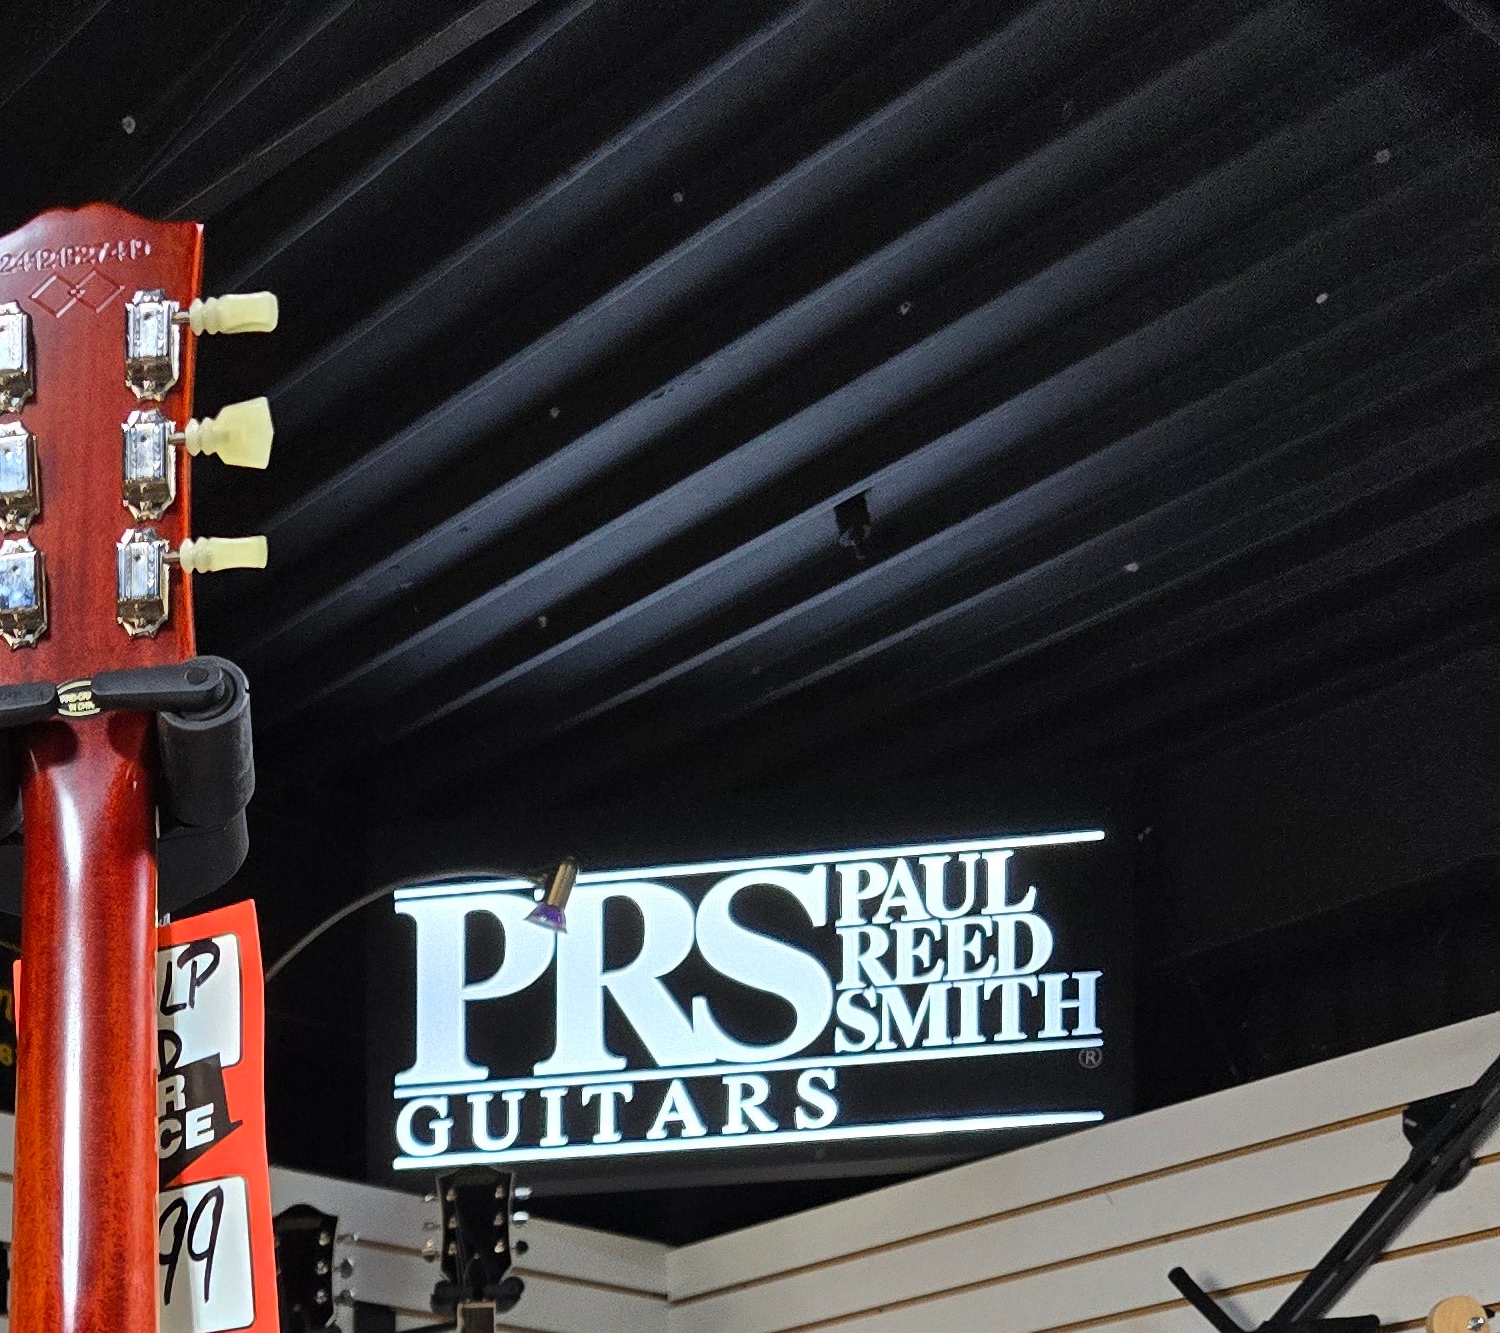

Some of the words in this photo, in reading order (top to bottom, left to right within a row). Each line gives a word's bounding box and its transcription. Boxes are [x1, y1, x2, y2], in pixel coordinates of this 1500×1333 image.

[835, 850, 1037, 927] PAUL
[395, 864, 836, 1086] PRS
[835, 912, 1054, 991] REED
[834, 971, 1103, 1053] SMITH
[395, 1069, 840, 1157] GUITARS
